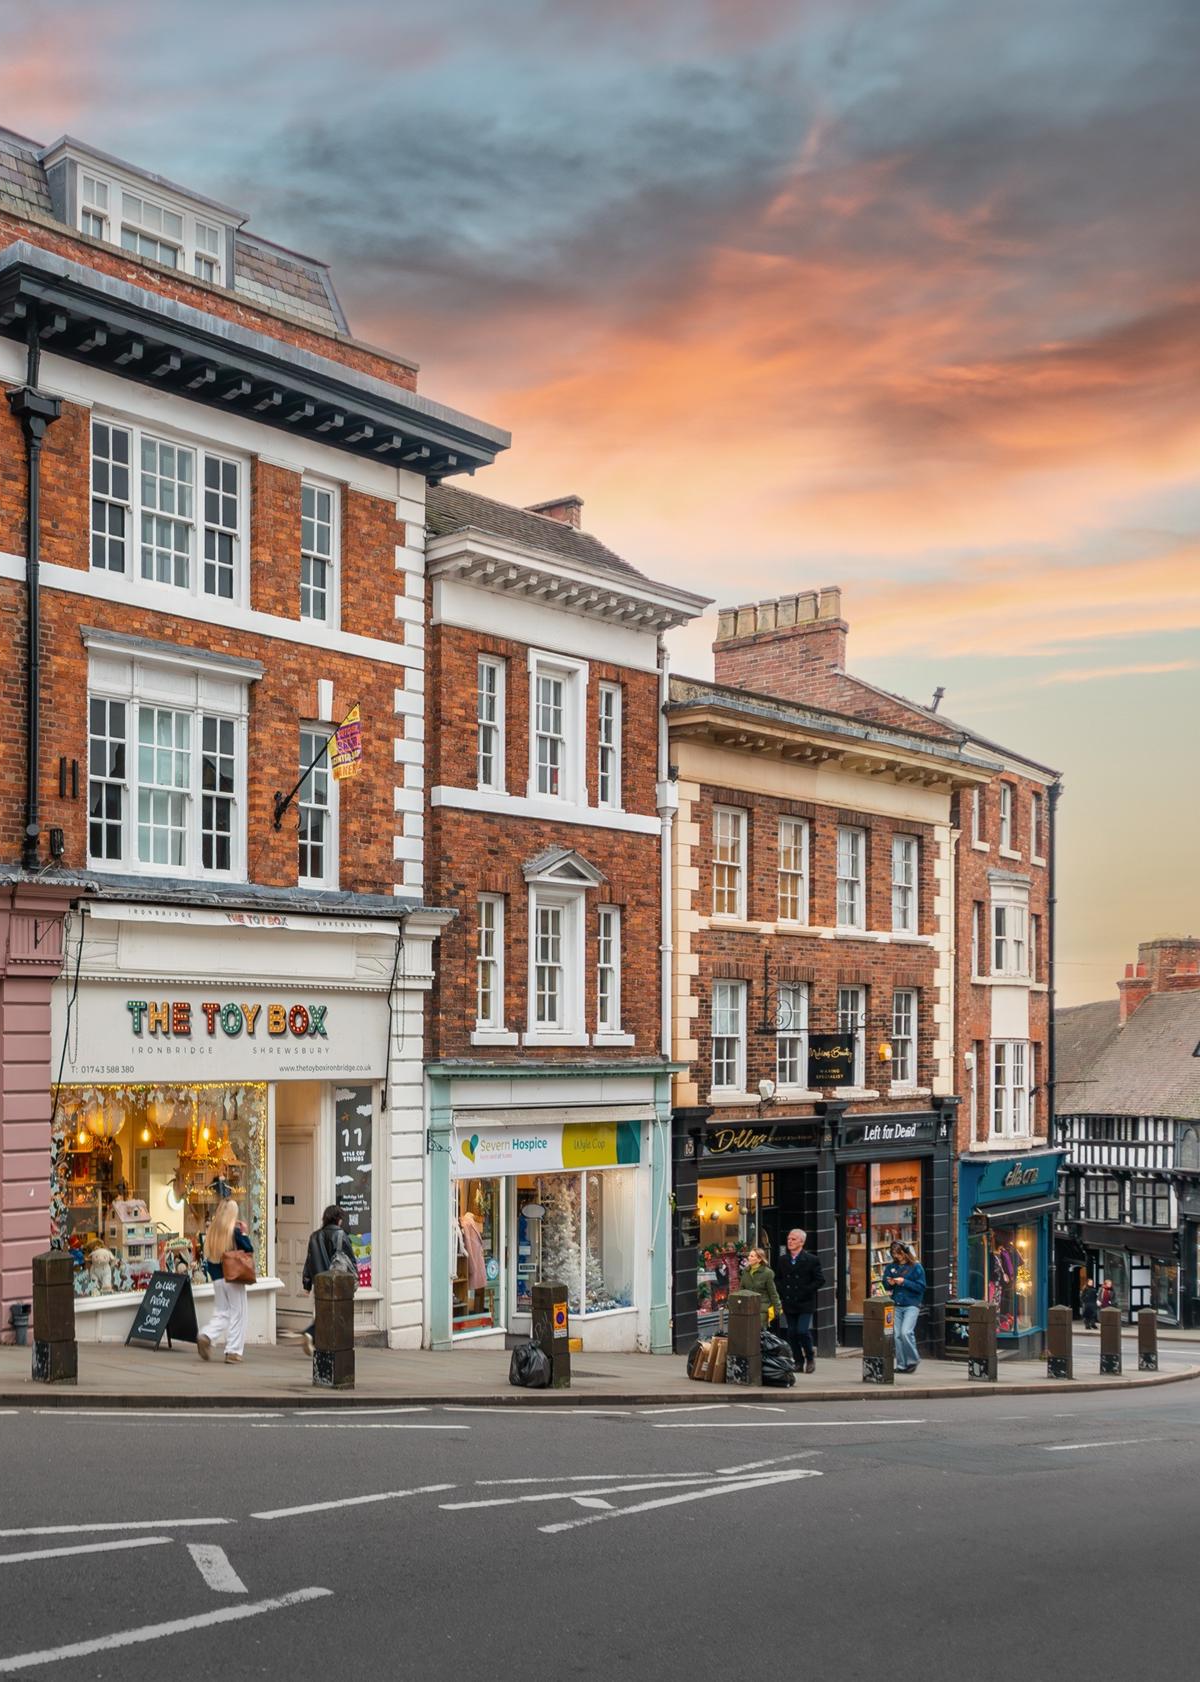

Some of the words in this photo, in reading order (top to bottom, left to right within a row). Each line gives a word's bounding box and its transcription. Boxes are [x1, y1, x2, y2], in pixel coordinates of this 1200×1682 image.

[128, 907, 192, 918] IRONBRIDGE
[224, 911, 245, 923] THE
[246, 912, 265, 924] TOY
[267, 914, 289, 926] BOX
[126, 1000, 191, 1036] THE
[202, 1002, 261, 1036] TOY
[268, 1004, 327, 1036] BOX
[131, 1046, 214, 1055] IRONBRIDGE
[252, 1047, 330, 1055] SHREWSBURY
[81, 1066, 105, 1074] 01743
[279, 1064, 372, 1073] www.thetoyboxironbridge.co.uk
[341, 1128, 363, 1147] 11
[864, 1125, 881, 1140] Left
[882, 1124, 894, 1139] for
[894, 1123, 917, 1138] Dead
[480, 1139, 511, 1152] Severn
[512, 1136, 548, 1153] Hospice
[574, 1137, 591, 1153] Wyle
